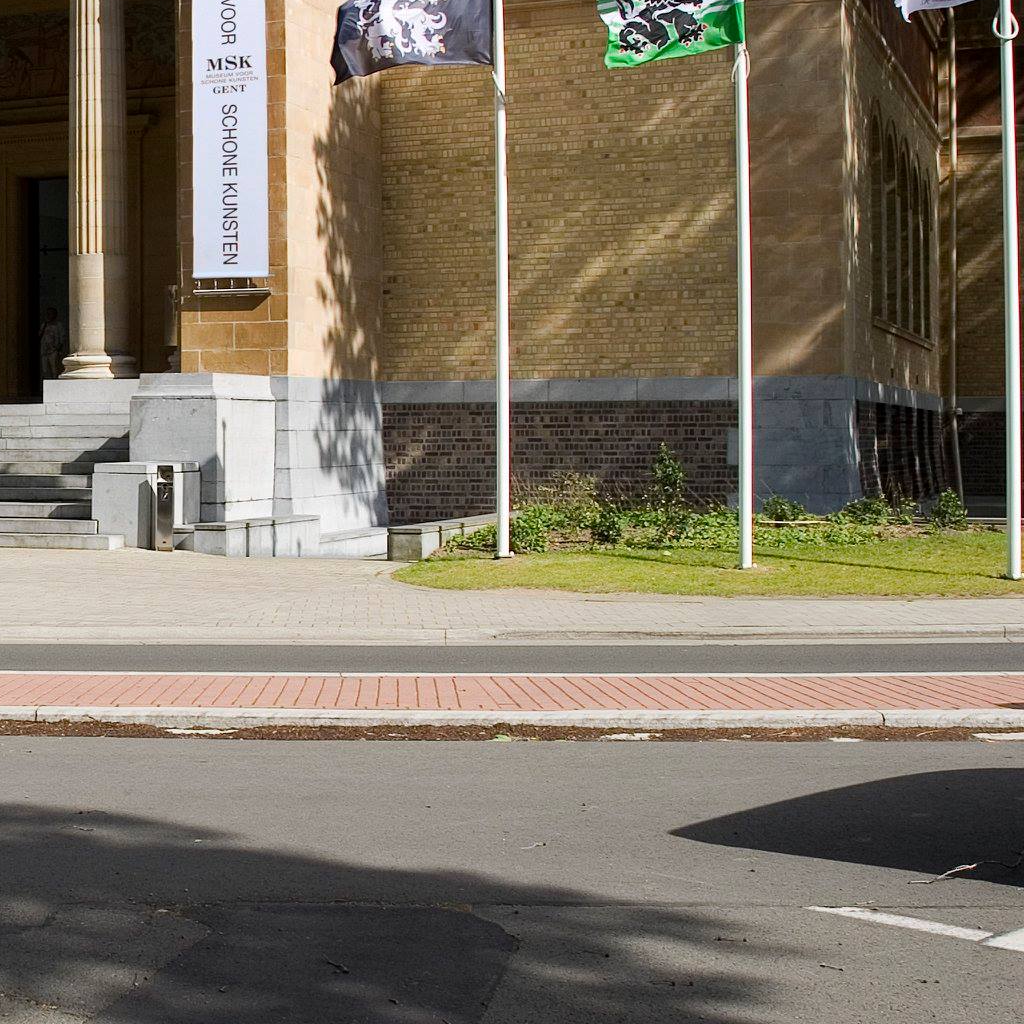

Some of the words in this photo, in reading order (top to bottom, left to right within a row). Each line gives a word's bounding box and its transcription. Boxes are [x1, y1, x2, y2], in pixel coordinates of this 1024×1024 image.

[206, 55, 253, 72] MSK
[213, 84, 247, 95] GENT
[221, 103, 238, 177] SCHONE
[221, 182, 239, 265] KUNSTEN
